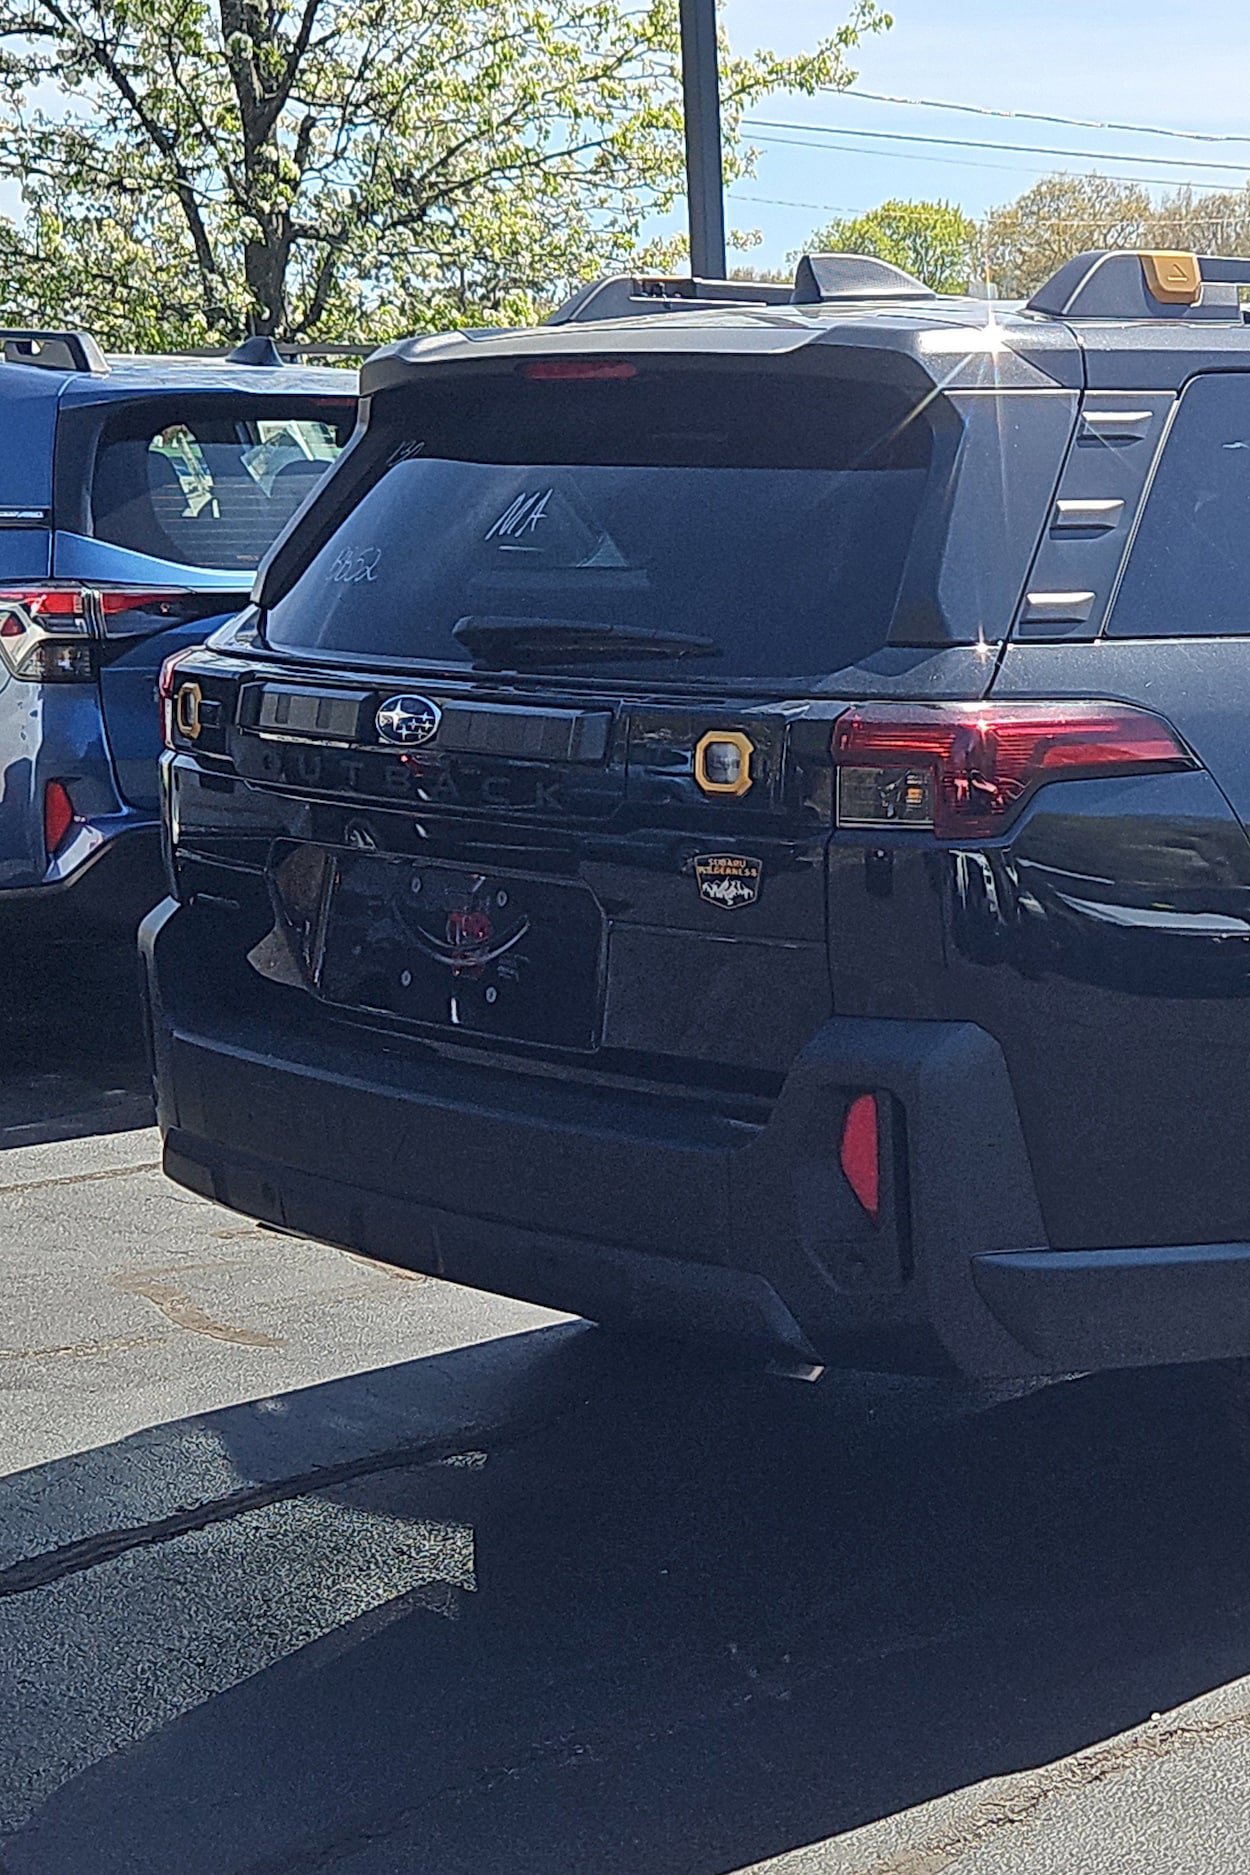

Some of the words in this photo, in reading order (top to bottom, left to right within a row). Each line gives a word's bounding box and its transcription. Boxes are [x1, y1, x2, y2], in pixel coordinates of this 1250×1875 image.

[484, 488, 554, 541] MA
[262, 752, 564, 810] OUTBACK
[696, 865, 759, 878] WILDERNESS
[707, 857, 747, 868] SUBARU
